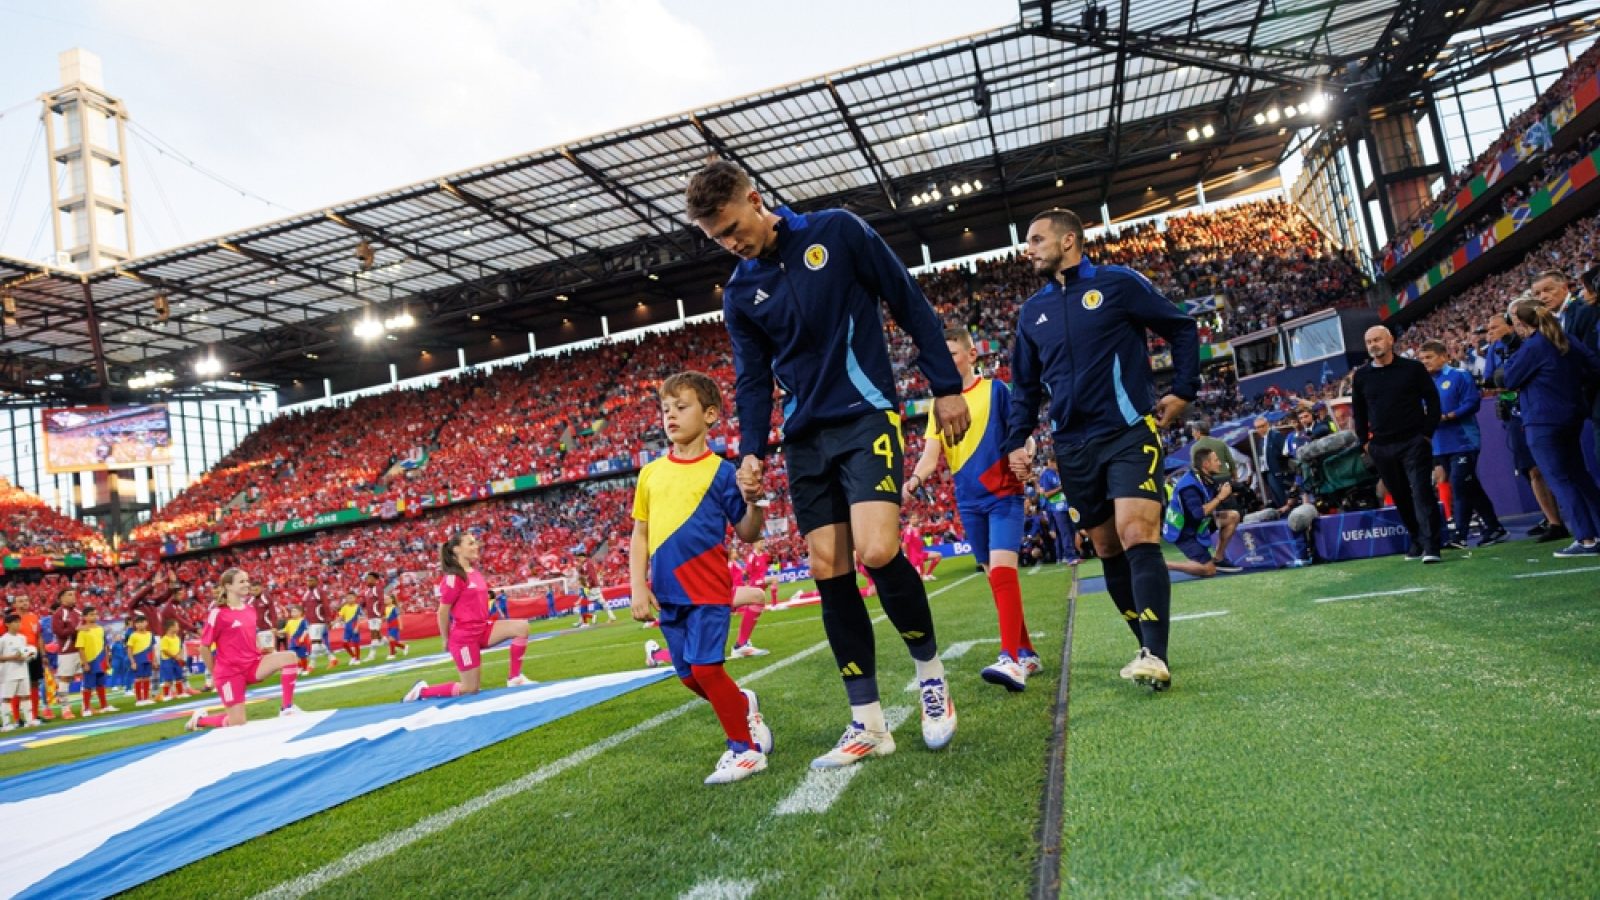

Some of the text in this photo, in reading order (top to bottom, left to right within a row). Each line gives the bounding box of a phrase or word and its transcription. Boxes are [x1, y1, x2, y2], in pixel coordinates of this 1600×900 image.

[873, 433, 894, 469] 4
[1143, 444, 1159, 474] 7
[292, 513, 337, 529] COGNE
